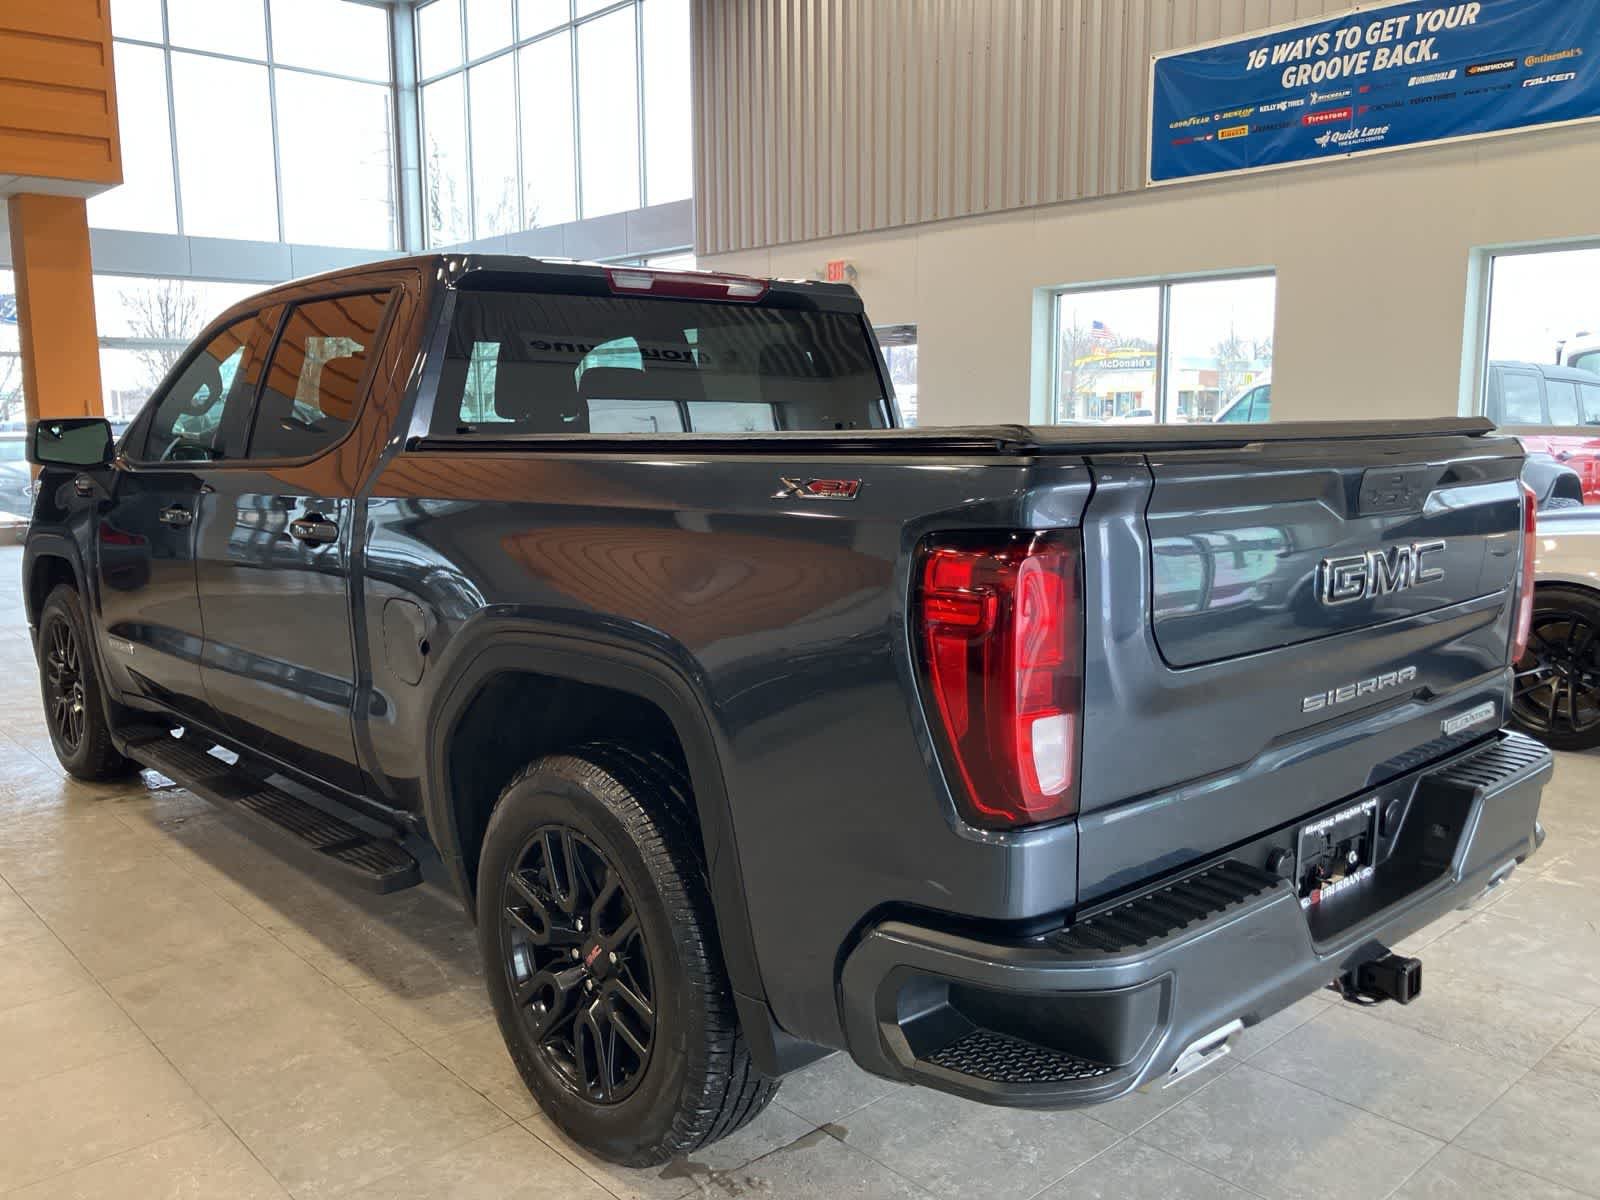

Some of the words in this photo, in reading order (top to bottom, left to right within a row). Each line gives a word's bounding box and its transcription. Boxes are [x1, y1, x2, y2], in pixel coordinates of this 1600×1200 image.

[1246, 47, 1269, 71] 16
[1271, 33, 1330, 65] WAYS
[1334, 26, 1361, 52] TO
[1365, 15, 1410, 45] GET
[1415, 2, 1481, 35] YOUR
[1281, 50, 1370, 89] GROOVE
[1372, 37, 1439, 71] BACK.
[1521, 72, 1577, 87] FALKEN
[1169, 115, 1211, 129] GOODYEAR
[1306, 110, 1348, 124] Firestone
[1331, 128, 1360, 143] Quick
[1361, 126, 1388, 138] Lane
[1099, 357, 1151, 370] McDonald's
[1318, 540, 1447, 607] GMC
[1301, 666, 1417, 713] SIERRA
[1311, 872, 1361, 905] SUBURBAN
